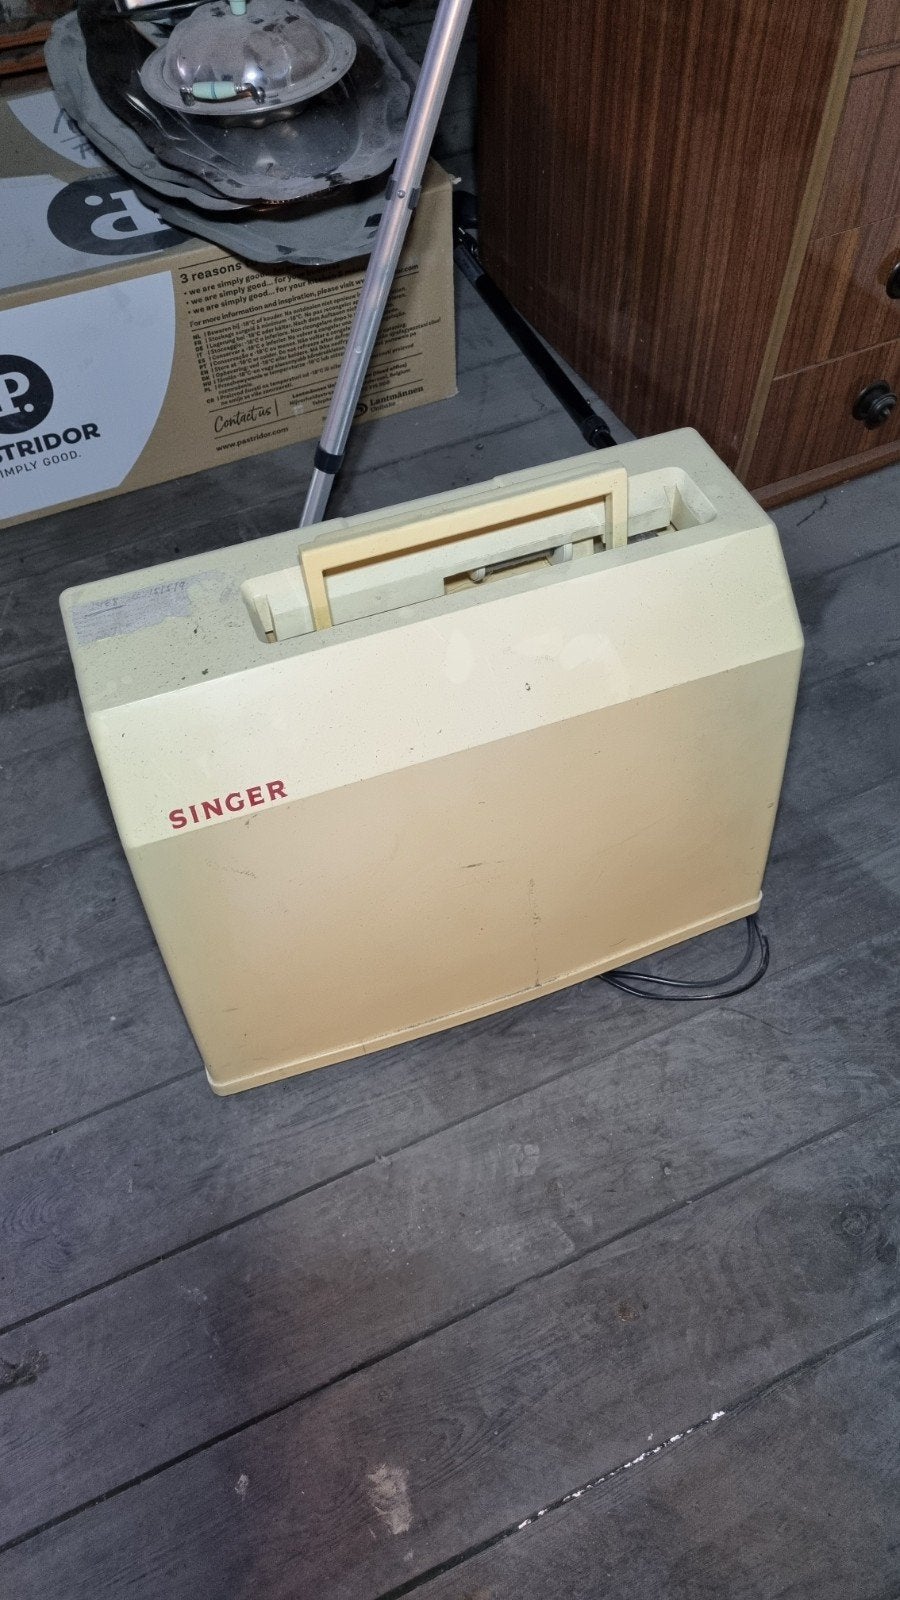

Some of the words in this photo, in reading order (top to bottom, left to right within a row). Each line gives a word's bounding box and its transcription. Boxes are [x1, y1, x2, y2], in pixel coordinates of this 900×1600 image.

[179, 272, 188, 284] 3
[191, 261, 241, 281] reasons
[188, 287, 200, 295] we
[201, 284, 215, 292] are
[216, 275, 244, 290] simply
[192, 306, 204, 314] we
[220, 294, 247, 308] simply
[275, 284, 287, 293] for
[288, 281, 305, 291] your
[203, 293, 217, 301] are
[218, 285, 245, 299] simply
[274, 274, 286, 284] for
[189, 319, 200, 327] For
[200, 315, 220, 324] more
[221, 303, 262, 319] information
[263, 299, 276, 308] and
[277, 289, 316, 305] inspiration,
[317, 283, 339, 295] please
[339, 280, 353, 289] visit
[369, 385, 423, 405] Lantmännen
[214, 406, 260, 433] Contact
[257, 407, 272, 417] us
[0, 422, 101, 463] TRIDOR
[215, 425, 288, 453] www.pastridor.com
[43, 450, 82, 467] GOOD.
[168, 779, 288, 829] SINGER
